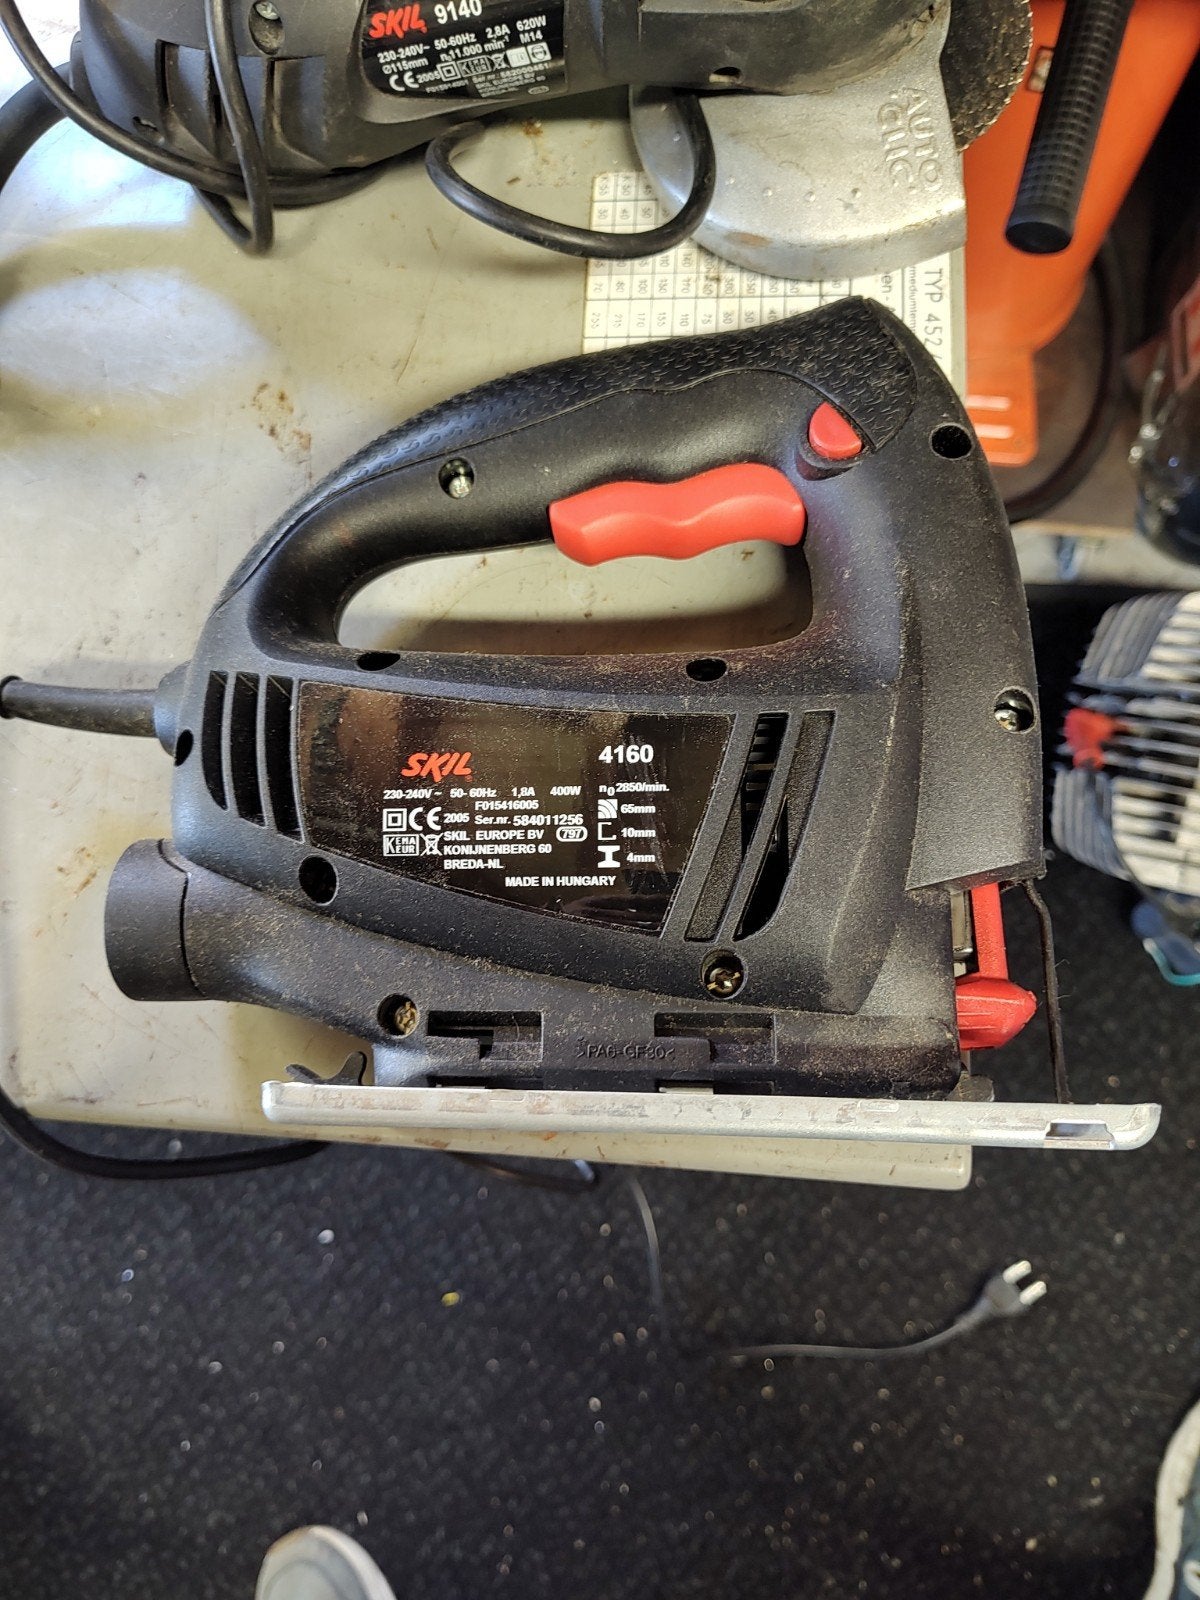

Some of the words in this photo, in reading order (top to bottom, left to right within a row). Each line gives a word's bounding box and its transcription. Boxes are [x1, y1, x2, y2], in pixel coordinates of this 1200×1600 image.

[434, 0, 482, 24] 9140
[369, 4, 427, 38] SKIL
[434, 32, 477, 50] 50-60Hz
[486, 24, 511, 38] 2,8A
[516, 15, 547, 31] 620W
[520, 30, 543, 44] M14
[417, 70, 441, 83] 2005
[924, 268, 943, 303] TYP
[598, 744, 654, 763] 4160
[401, 752, 472, 782] SKIL
[511, 787, 535, 798] 1,8A
[550, 785, 582, 796] 400W
[475, 800, 539, 811] F015416005
[621, 804, 656, 814] 65mm
[444, 813, 470, 823] 2005
[513, 814, 583, 827] 584011256
[444, 831, 470, 841] SKIL
[476, 830, 525, 840] EUROPE
[527, 829, 544, 840] BV
[621, 827, 656, 838] 10mm
[538, 844, 552, 854] 60
[627, 852, 656, 863] 4mm
[444, 859, 504, 870] BREDA-NL
[505, 876, 540, 887] MADE
[542, 876, 555, 887] IN
[556, 875, 616, 887] HUNGARY
